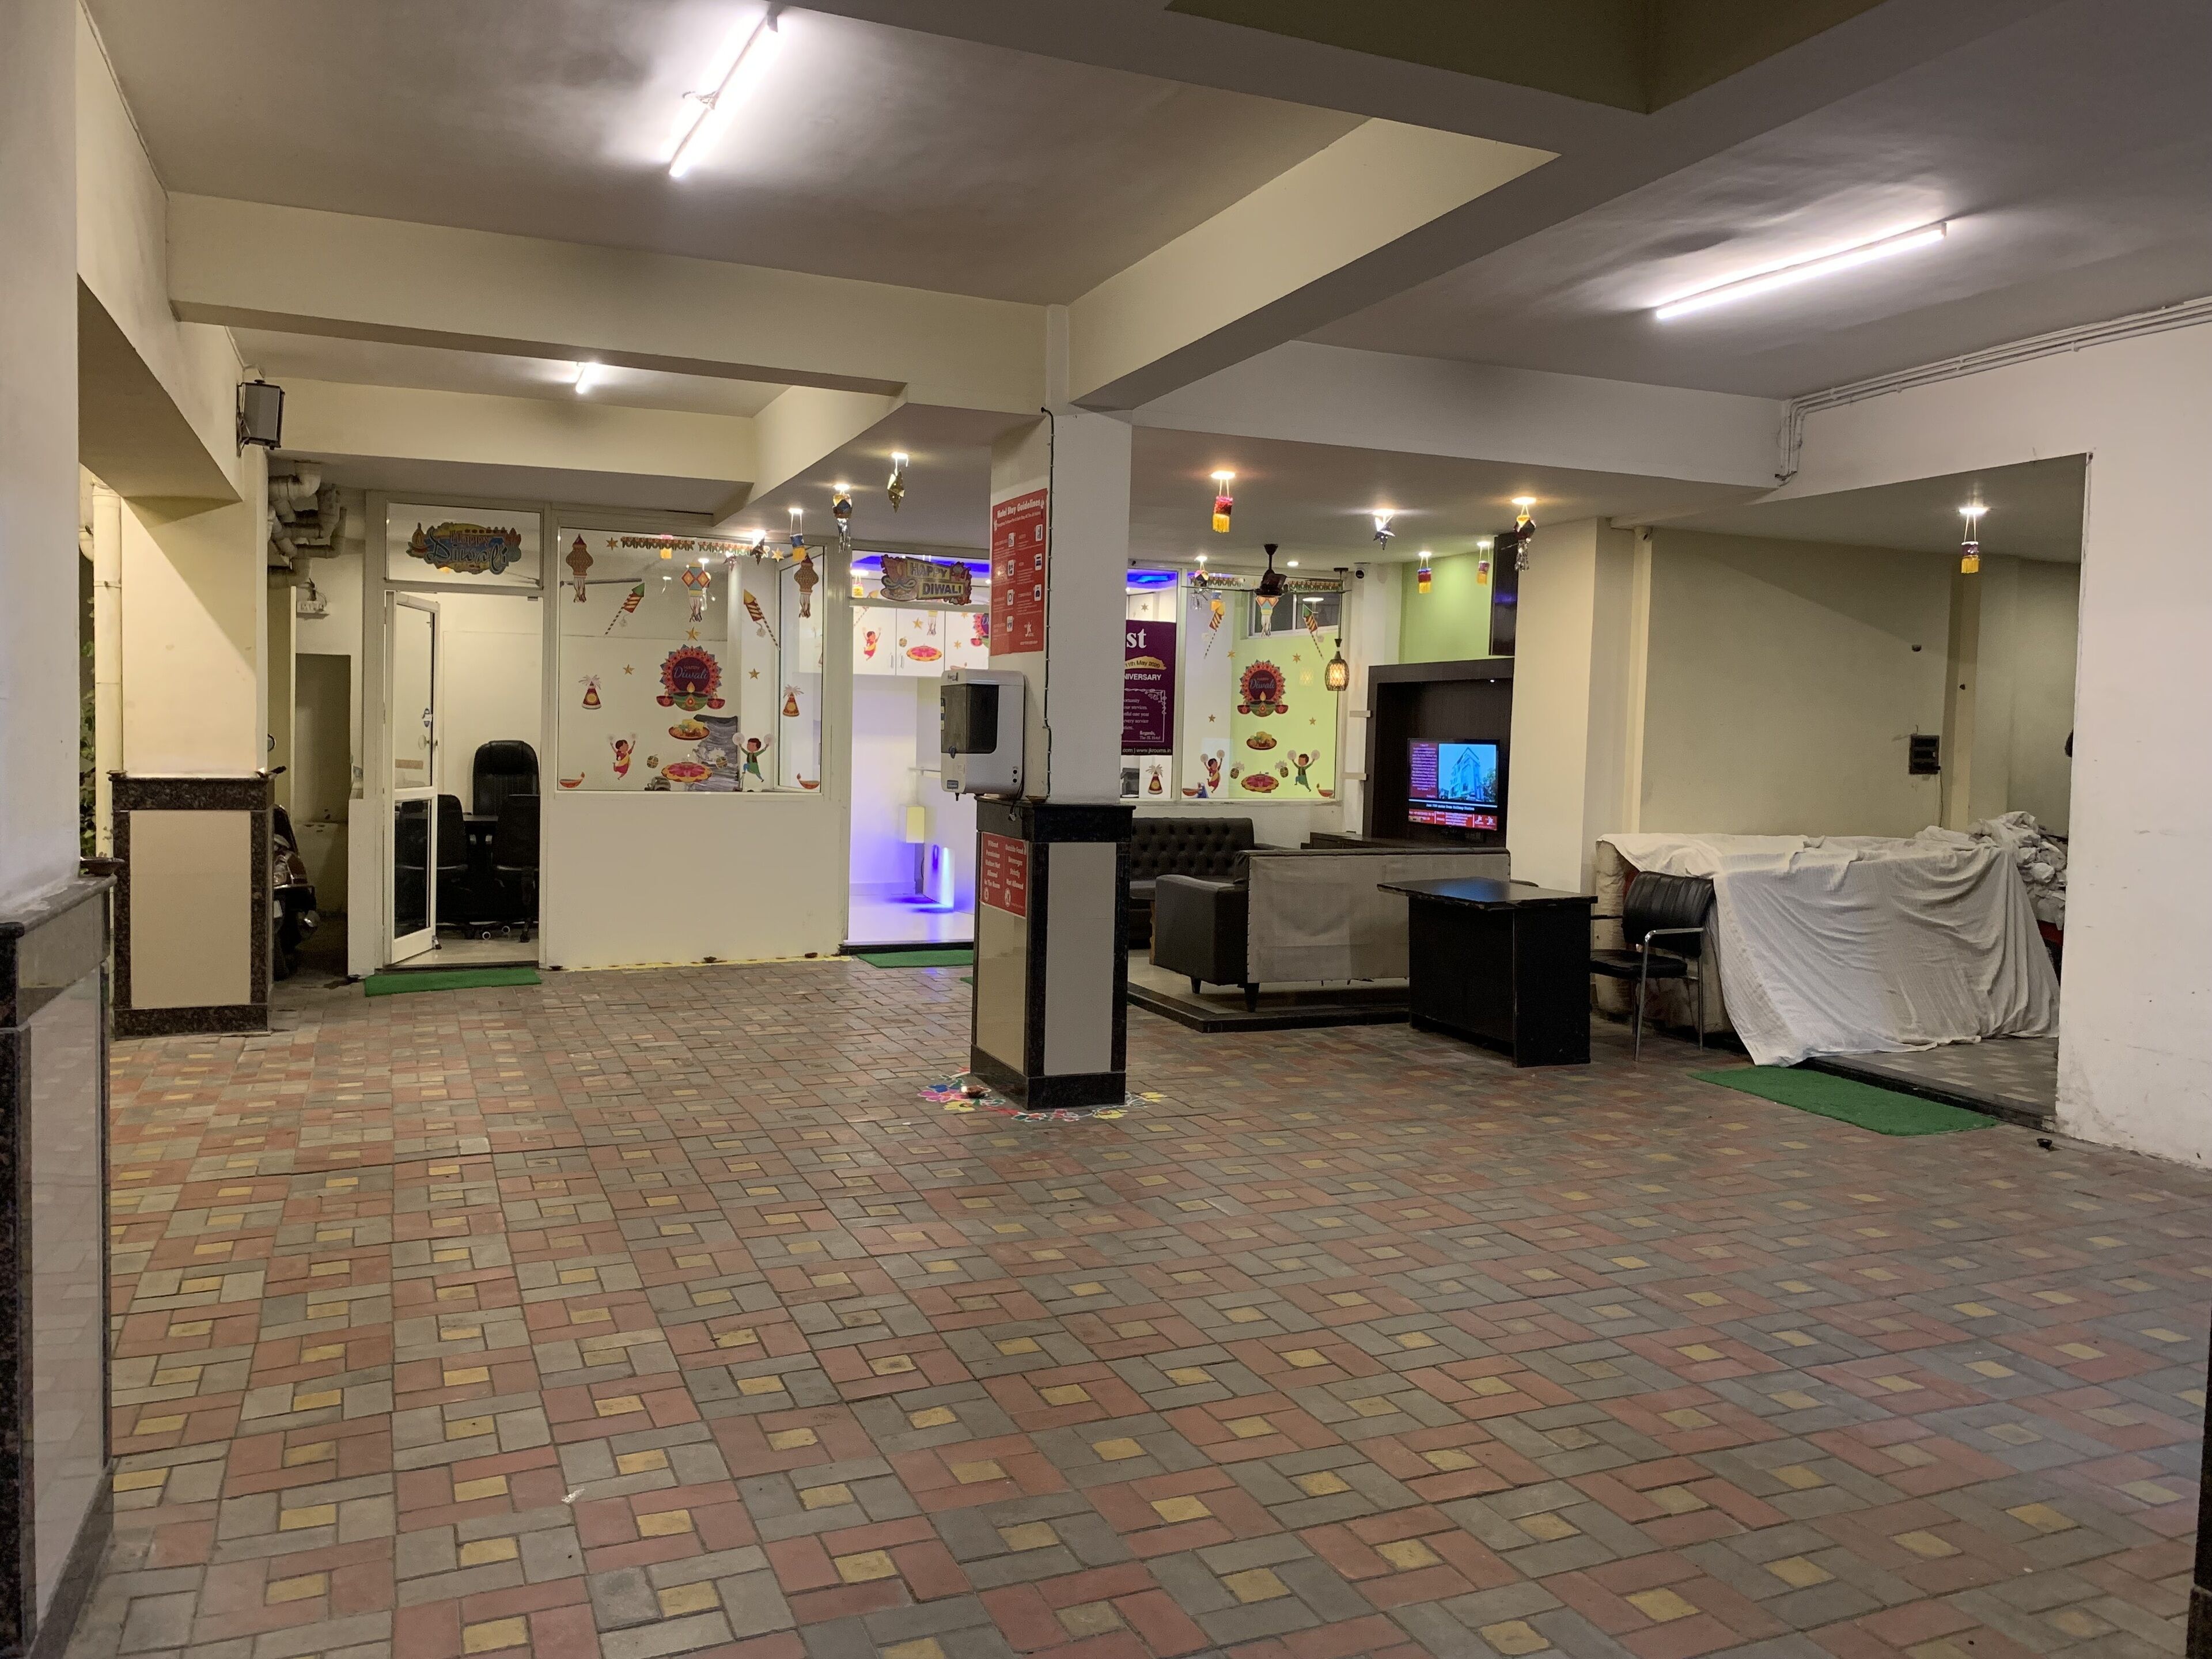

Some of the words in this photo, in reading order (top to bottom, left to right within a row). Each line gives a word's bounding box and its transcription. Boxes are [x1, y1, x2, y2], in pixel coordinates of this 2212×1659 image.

[997, 507, 1007, 518] Hotel
[1007, 506, 1016, 515] Stay
[1017, 499, 1040, 512] Guidelines
[425, 527, 508, 574] Diwali
[911, 562, 948, 579] HAPPY
[922, 583, 961, 594] DIWALI
[674, 666, 708, 679] Diwali
[1250, 679, 1274, 690] Diwali
[1012, 880, 1024, 890] Allowed
